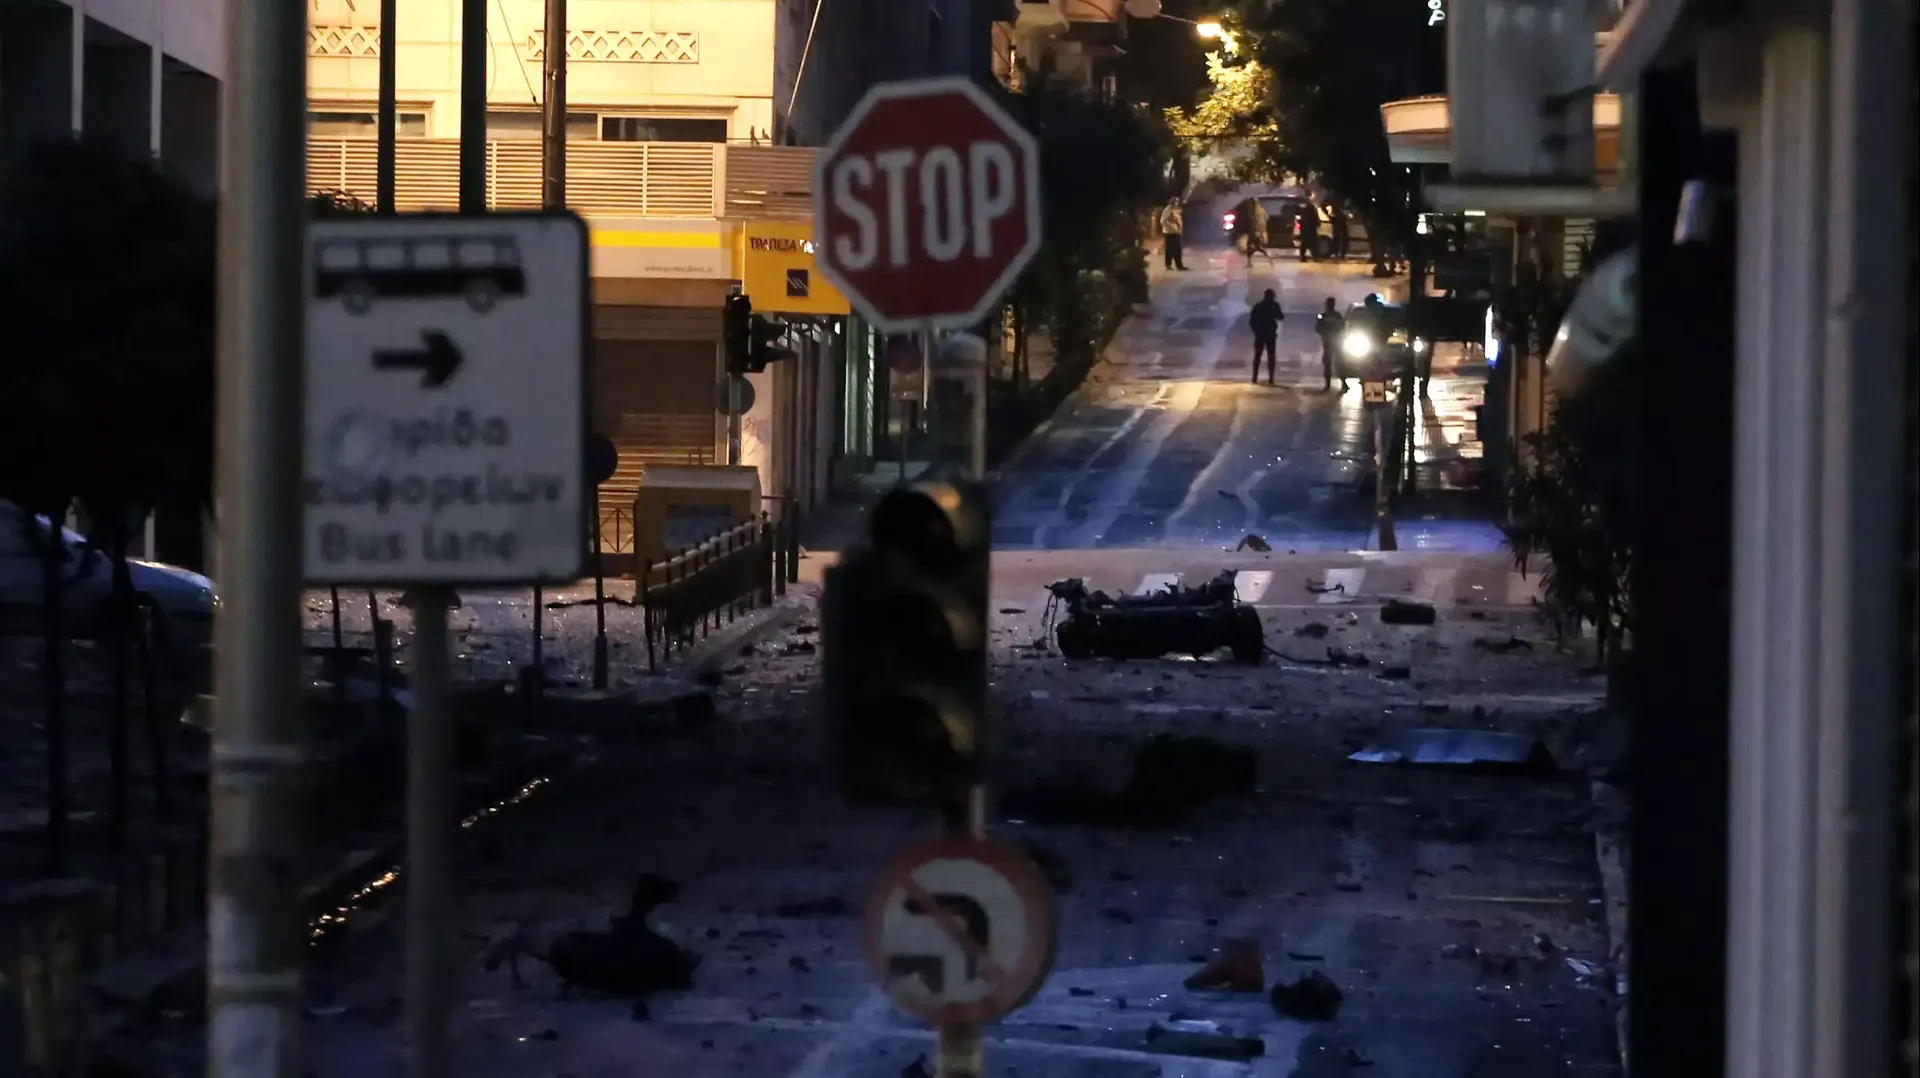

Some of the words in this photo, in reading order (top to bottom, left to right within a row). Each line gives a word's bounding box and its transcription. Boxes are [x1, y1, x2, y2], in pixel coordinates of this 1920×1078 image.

[833, 140, 1016, 270] STOP
[330, 410, 514, 458] ρίδα
[318, 522, 406, 562] Bus
[421, 523, 519, 562] lane
